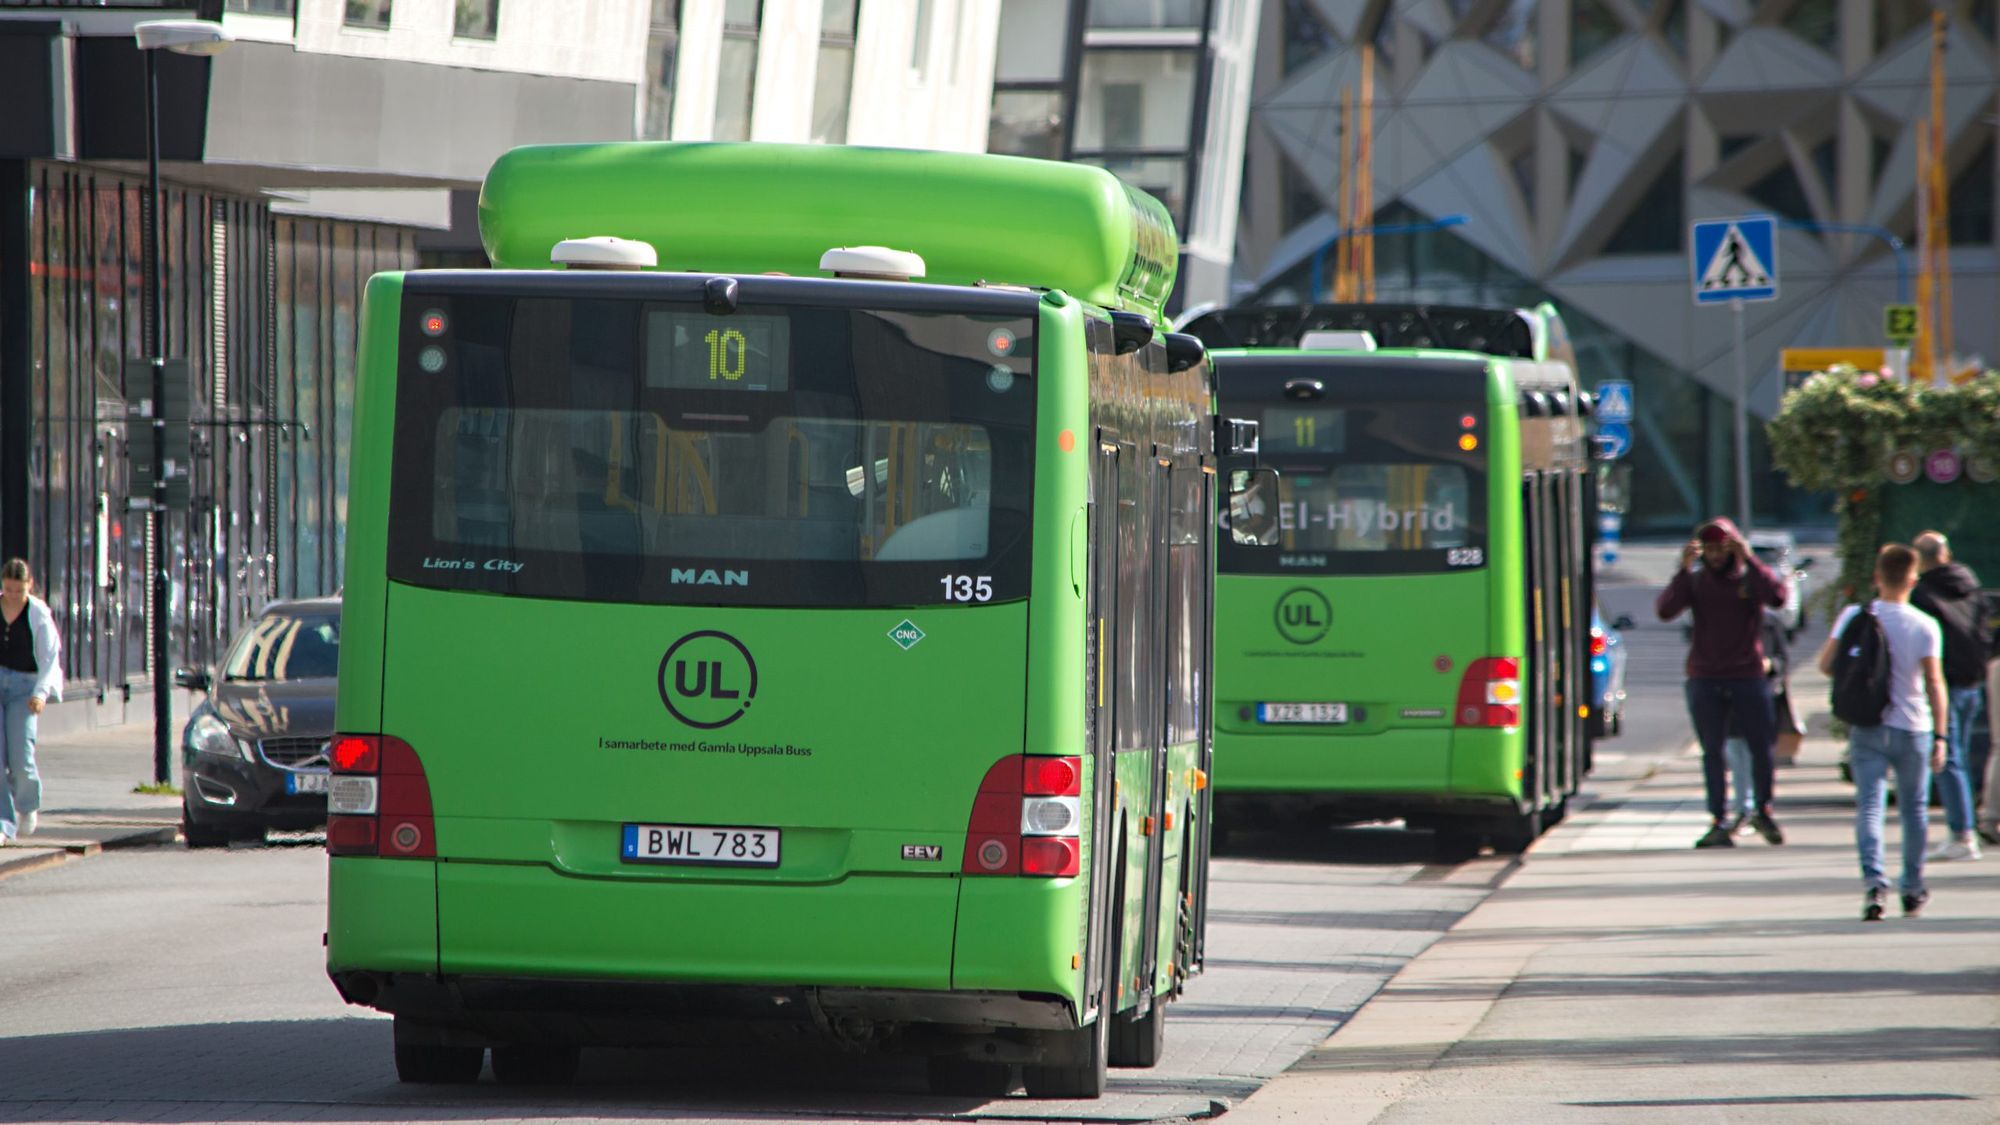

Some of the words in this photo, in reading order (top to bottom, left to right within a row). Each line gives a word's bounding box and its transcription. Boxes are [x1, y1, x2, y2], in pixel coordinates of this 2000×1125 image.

[705, 330, 745, 380] 10
[1294, 416, 1315, 447] 11
[1279, 502, 1455, 538] El-Hybrid
[423, 557, 475, 570] Lion's
[483, 558, 525, 573] City
[670, 568, 749, 587] MAN
[940, 574, 993, 602] 135
[1283, 604, 1323, 627] UL
[896, 629, 918, 640] CNG
[675, 660, 740, 699] UL
[1309, 703, 1342, 722] 132
[599, 737, 603, 749] I
[604, 739, 667, 751] samarbete
[669, 741, 695, 752] med
[698, 742, 736, 754] Gamla
[737, 743, 784, 757] Uppsala
[785, 745, 812, 757] Buss
[648, 830, 700, 857] BWL
[712, 832, 767, 858] 783
[903, 845, 941, 860] EEV
